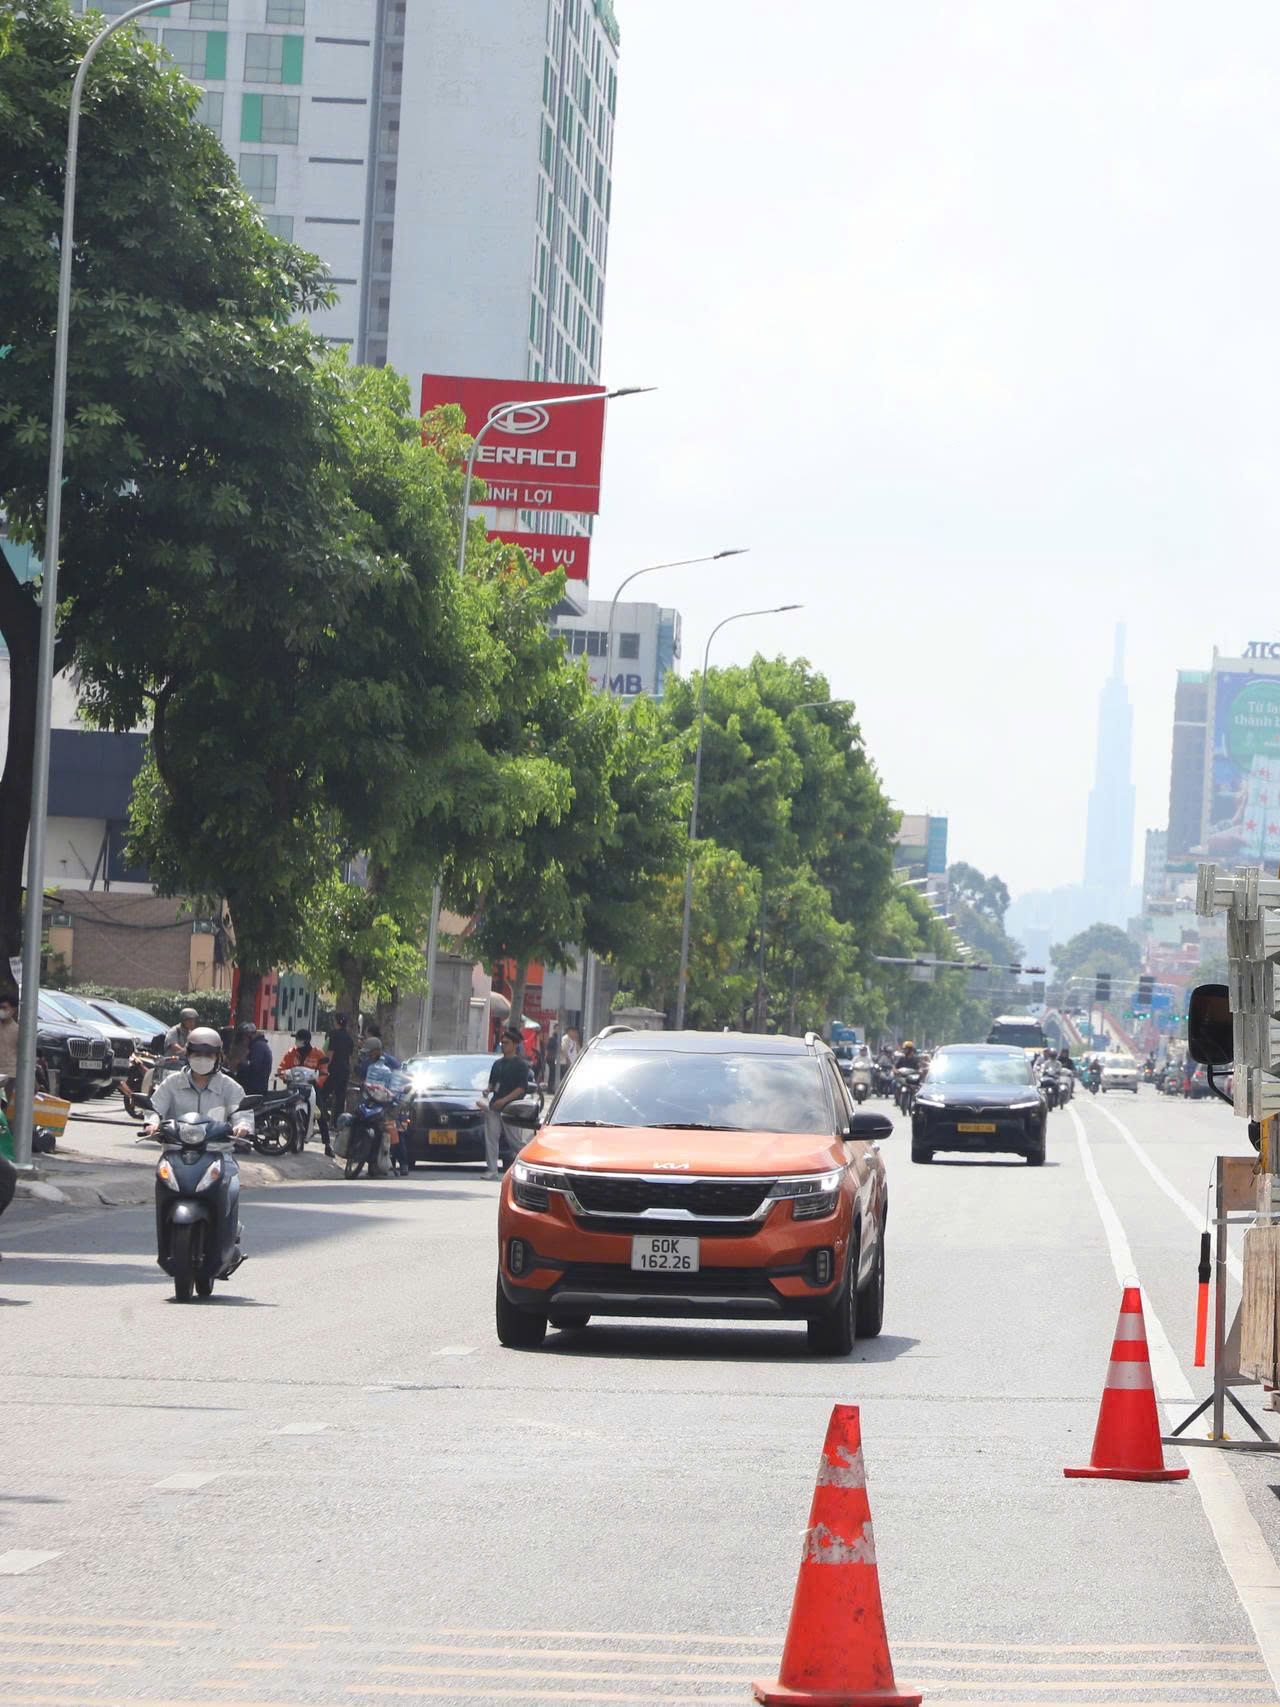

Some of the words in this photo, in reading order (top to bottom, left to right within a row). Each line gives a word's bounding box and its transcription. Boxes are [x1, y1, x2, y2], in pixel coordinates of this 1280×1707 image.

[465, 444, 577, 467] ERACO
[551, 549, 576, 567] VỤ
[651, 1239, 680, 1254] 60K
[641, 1254, 691, 1269] 162.26
